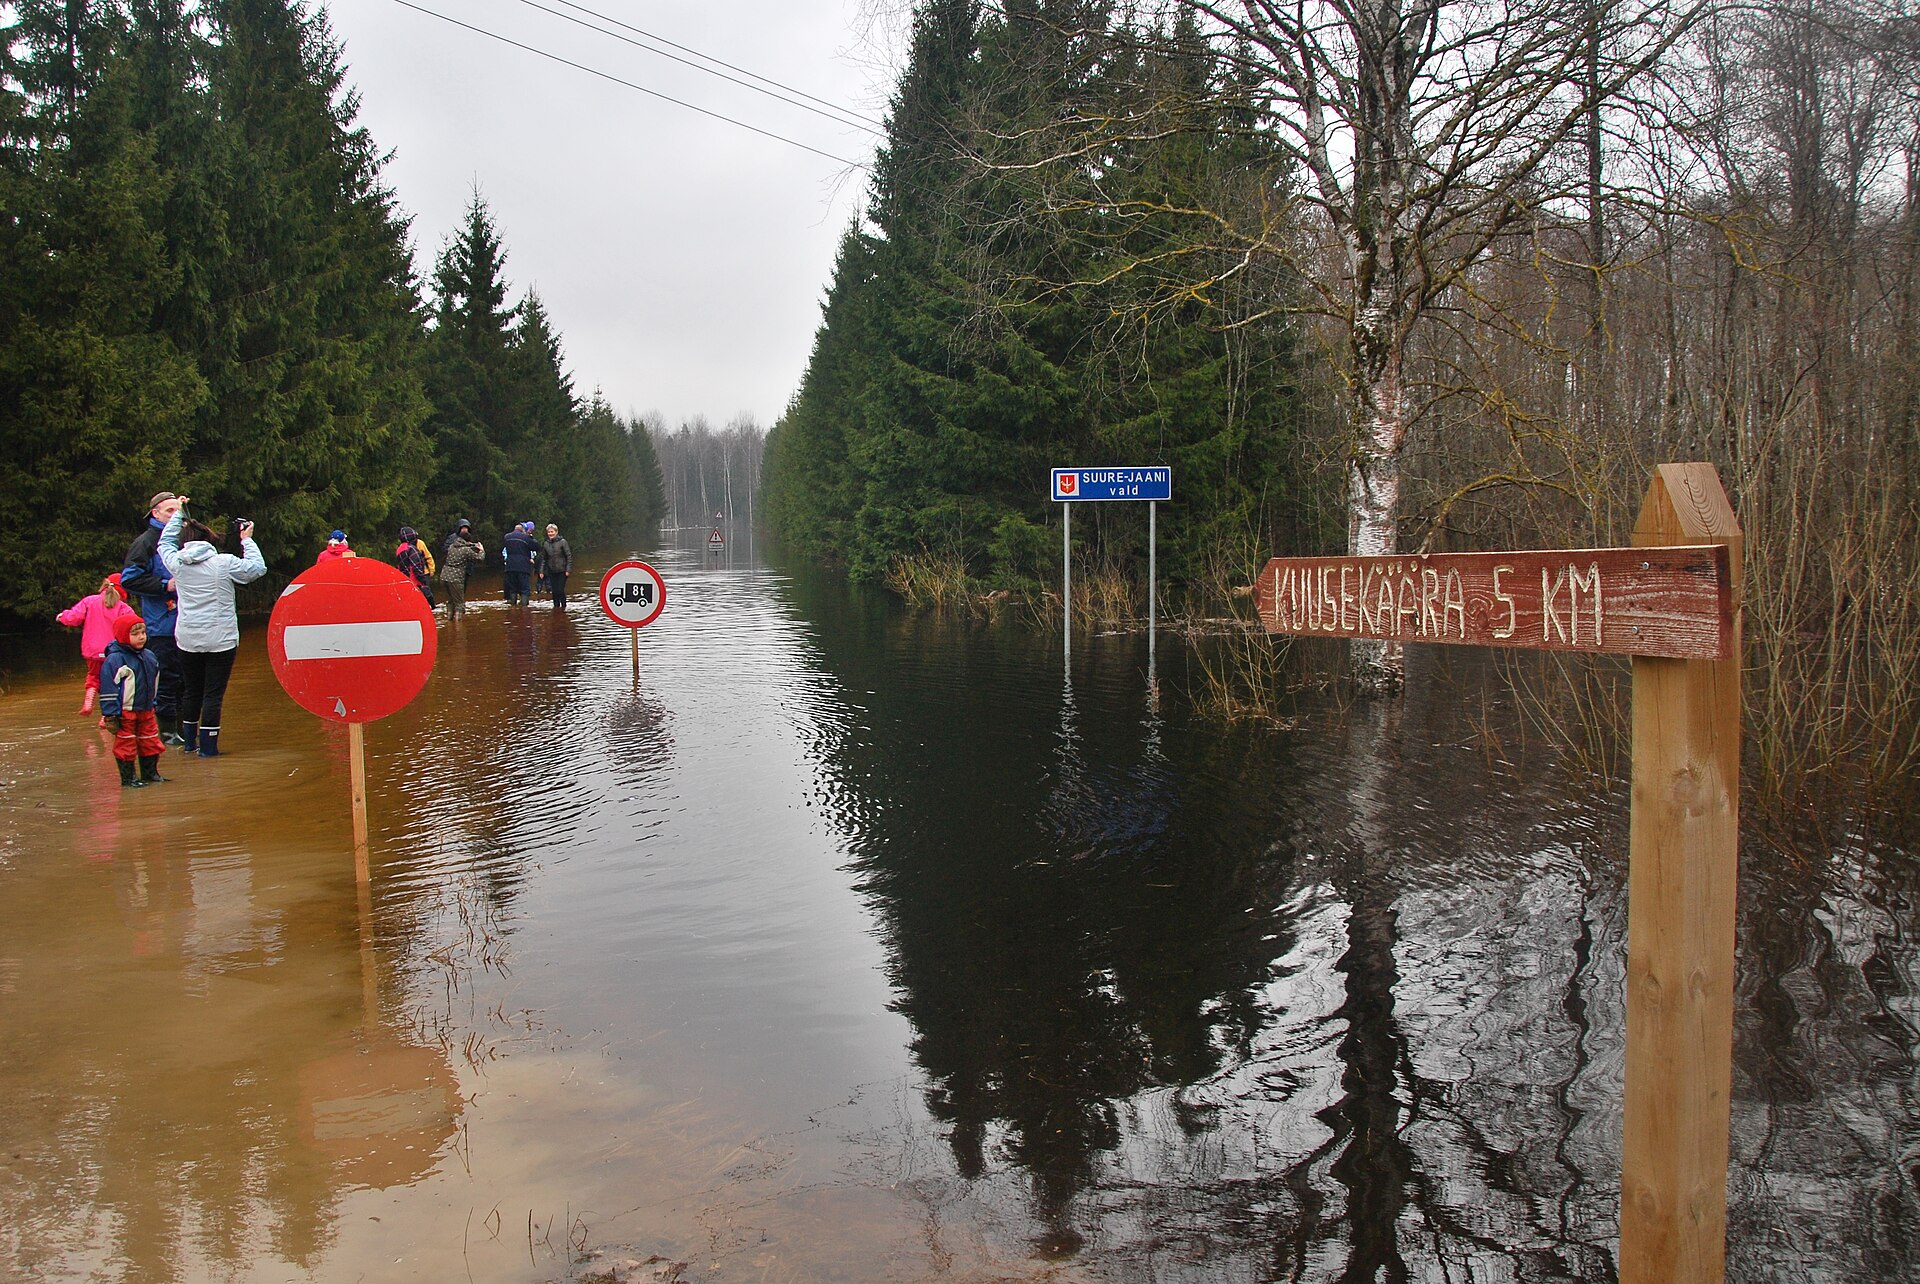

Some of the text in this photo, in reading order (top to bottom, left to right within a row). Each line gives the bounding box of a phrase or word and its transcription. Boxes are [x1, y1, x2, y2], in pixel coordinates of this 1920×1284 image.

[1082, 471, 1166, 484] SUURE-JAANI
[1109, 485, 1139, 496] vald
[1273, 560, 1603, 646] KUUSEKÄÄRA 5 KM
